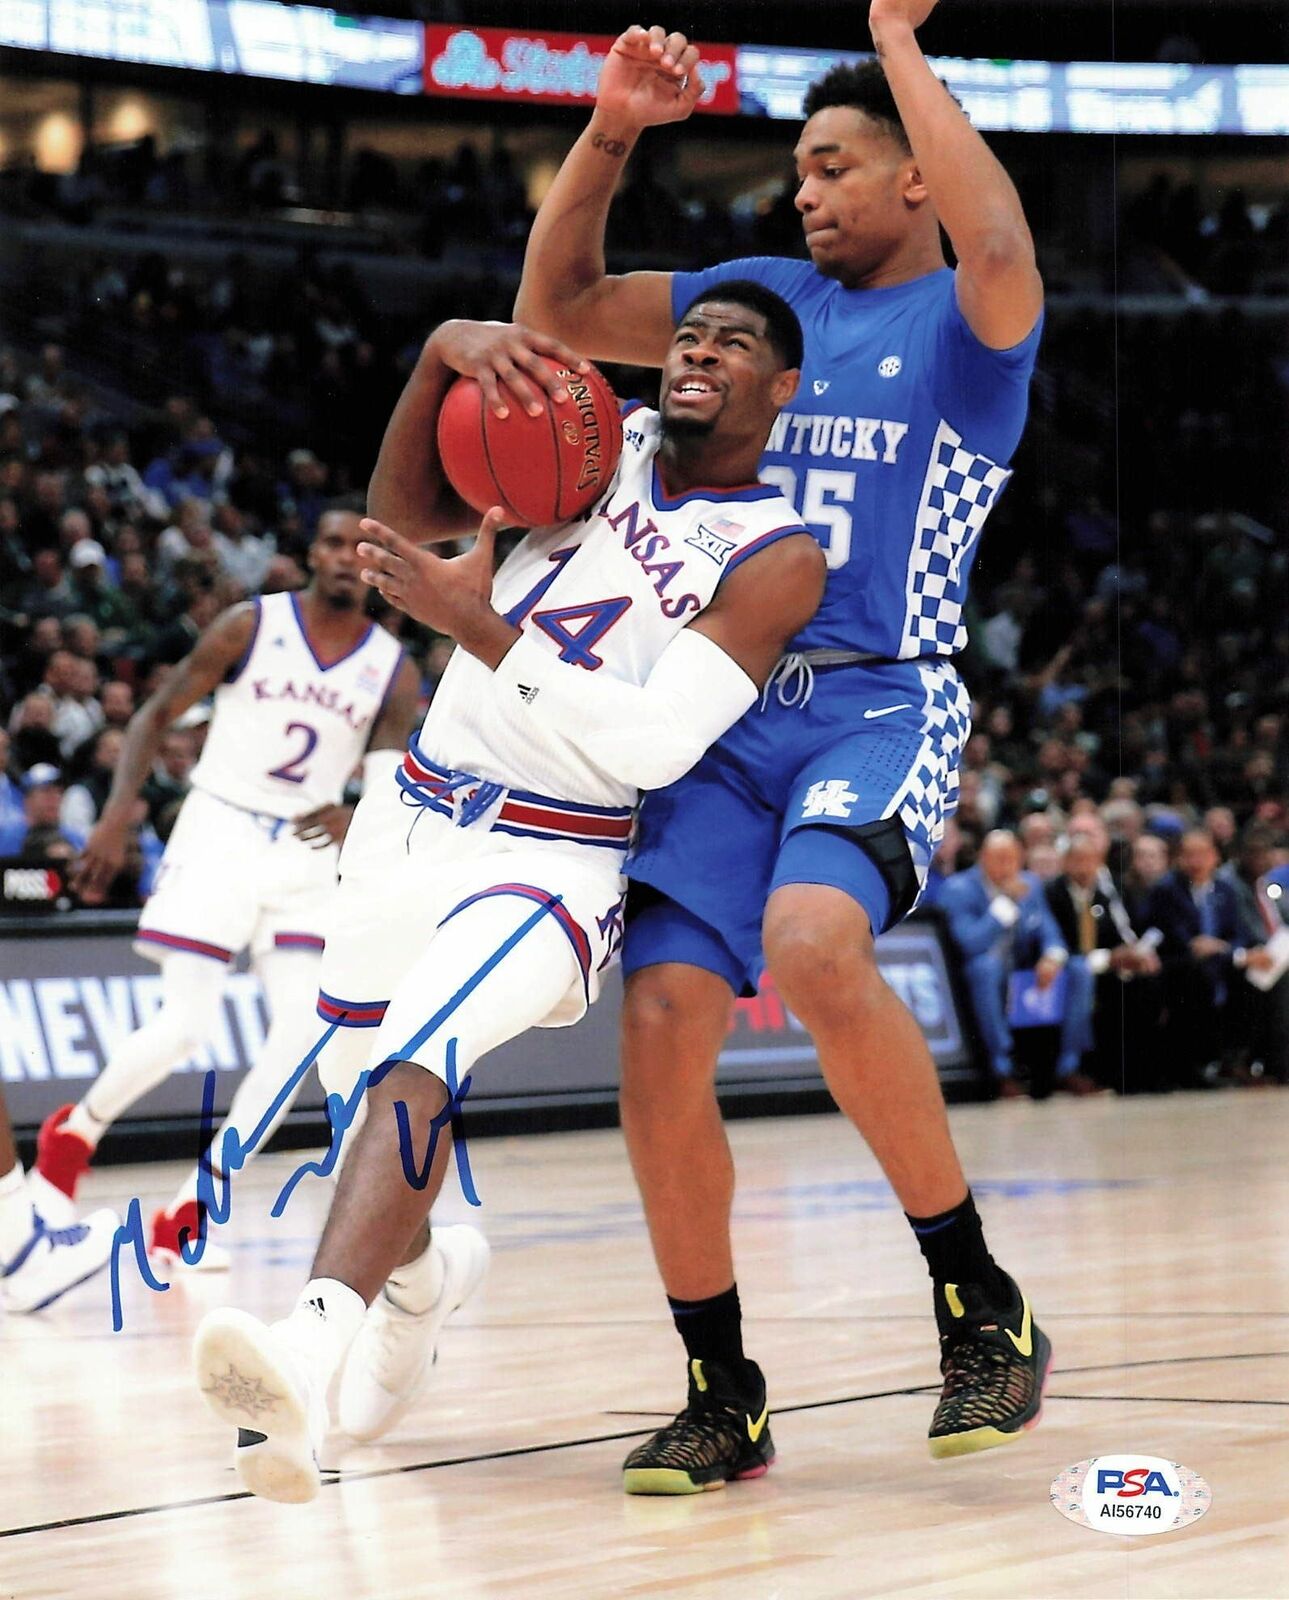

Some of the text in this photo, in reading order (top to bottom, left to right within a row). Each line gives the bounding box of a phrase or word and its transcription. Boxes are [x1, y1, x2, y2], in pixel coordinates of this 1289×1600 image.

[764, 411, 909, 464] NTUCKY
[504, 543, 634, 671] 14
[268, 721, 319, 784] 2
